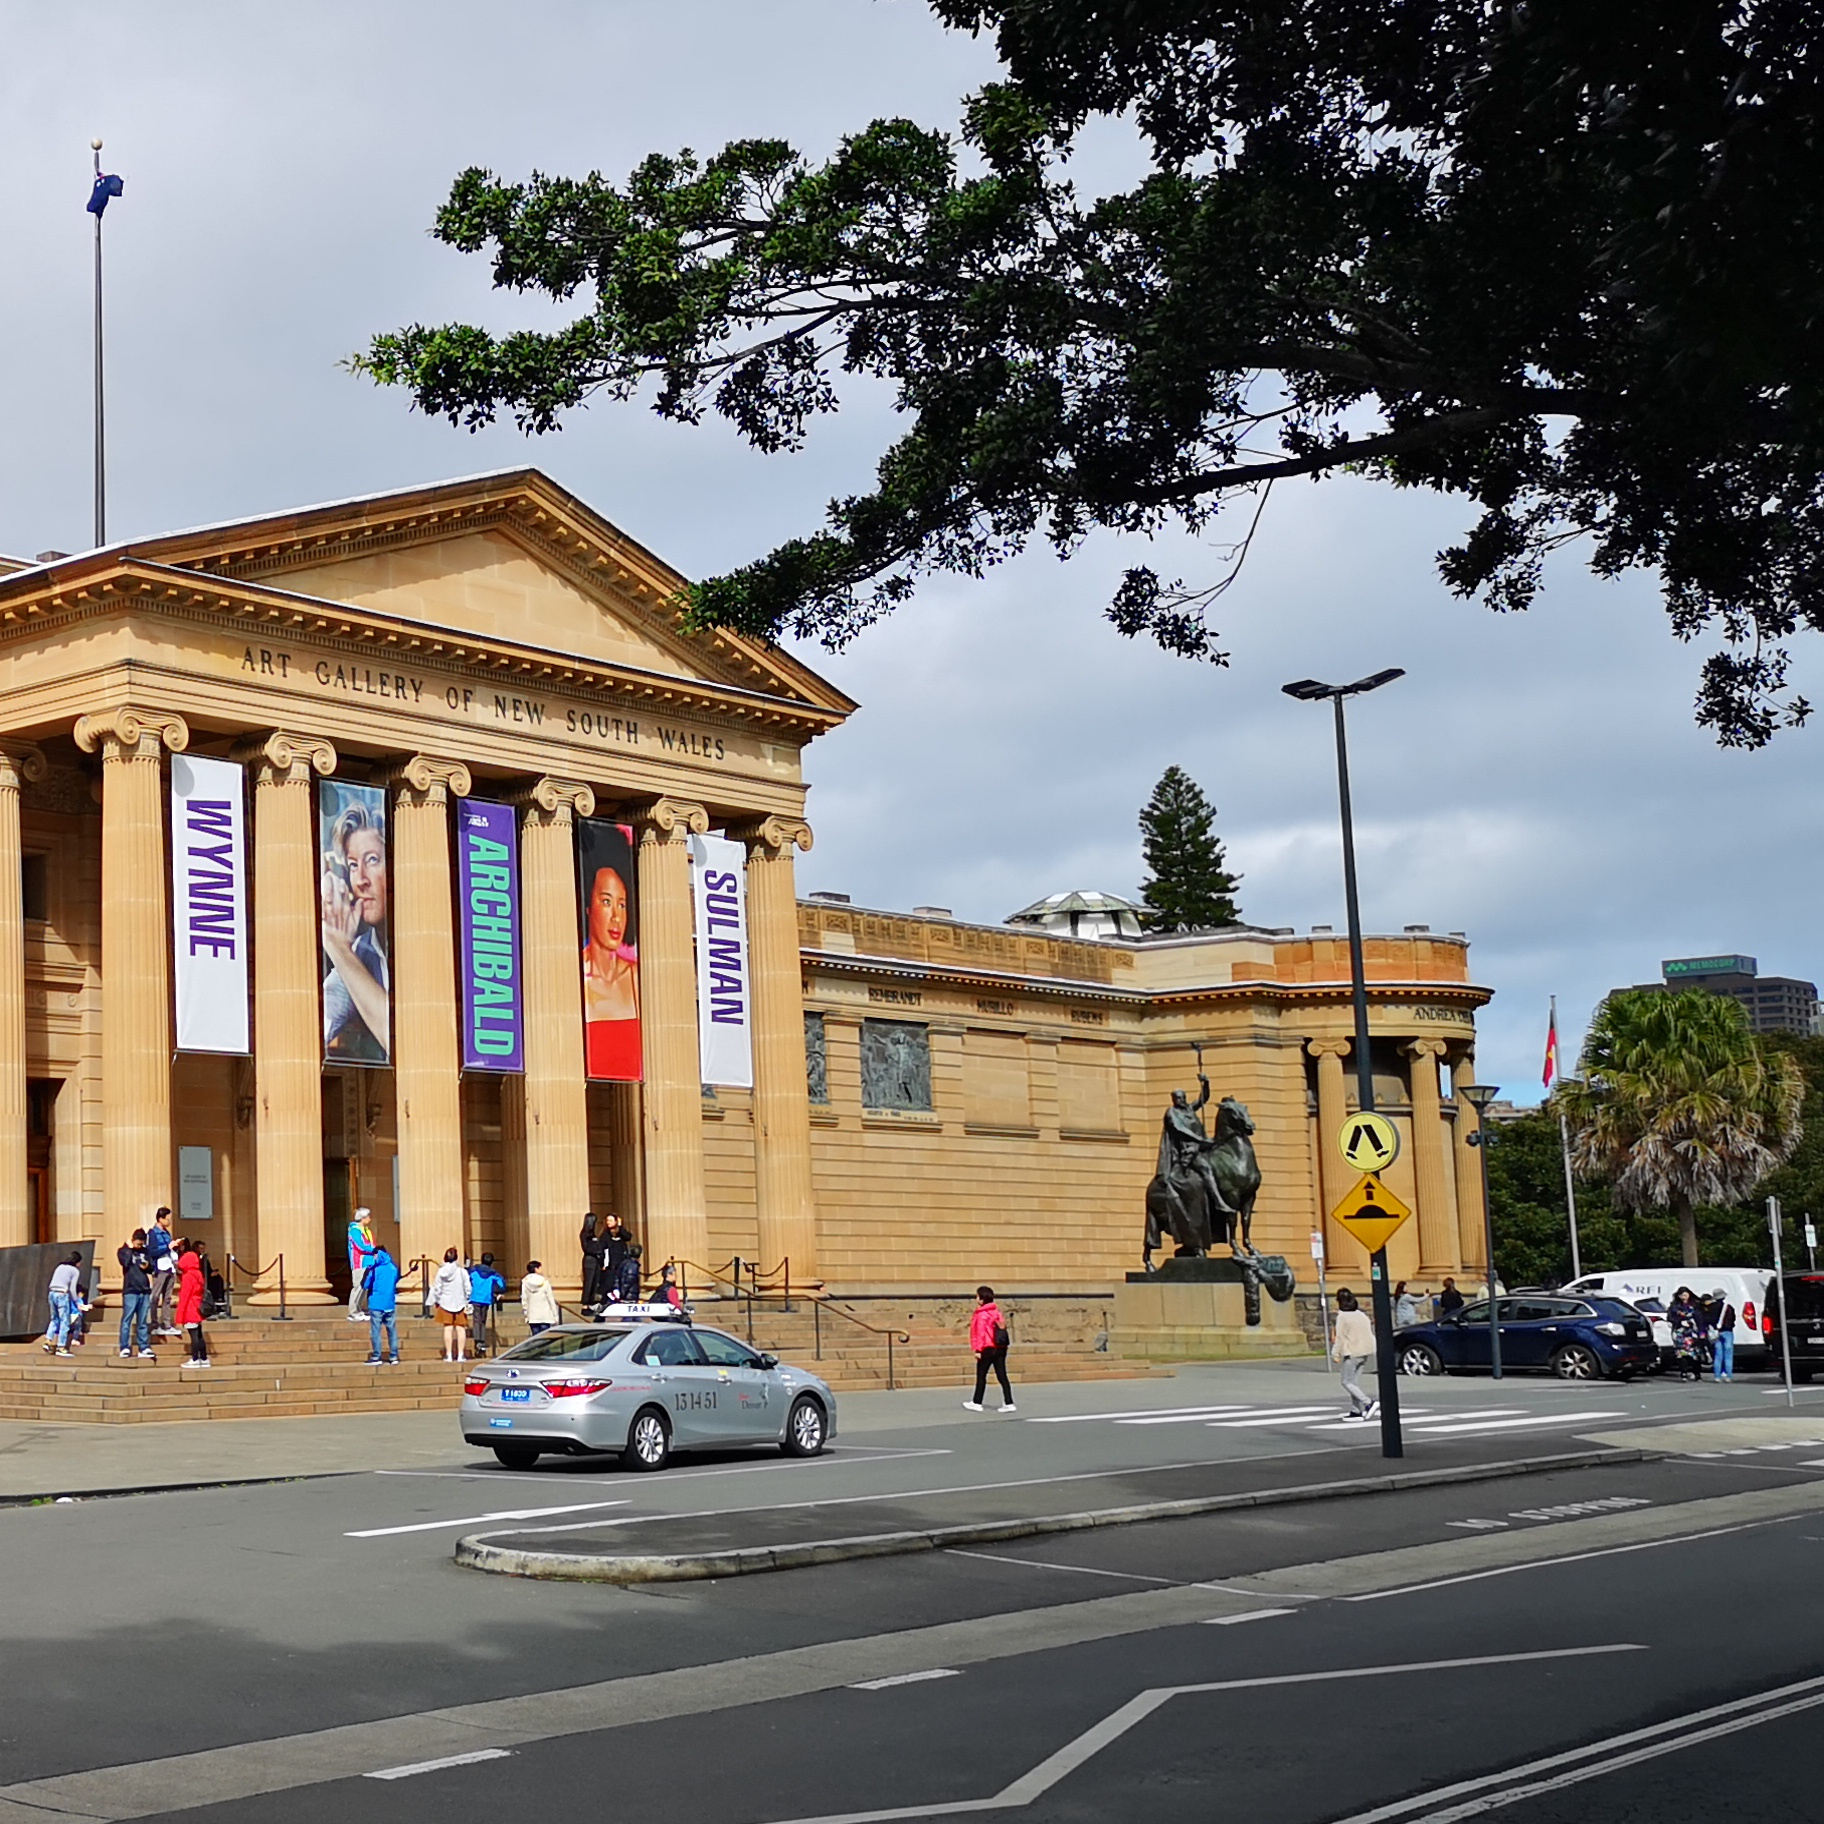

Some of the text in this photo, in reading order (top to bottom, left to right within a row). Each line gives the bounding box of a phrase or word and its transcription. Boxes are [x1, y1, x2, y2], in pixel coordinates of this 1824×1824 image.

[241, 646, 726, 761] ART GALLERY OF NEW SOUTH WALES
[186, 799, 236, 961] WYNNE
[468, 833, 516, 1057] ARCHIBALD
[704, 869, 744, 1026] SULMAN
[627, 1305, 651, 1313] TAXI
[675, 1393, 688, 1411] 13
[690, 1392, 702, 1410] 14
[704, 1391, 718, 1410] 51
